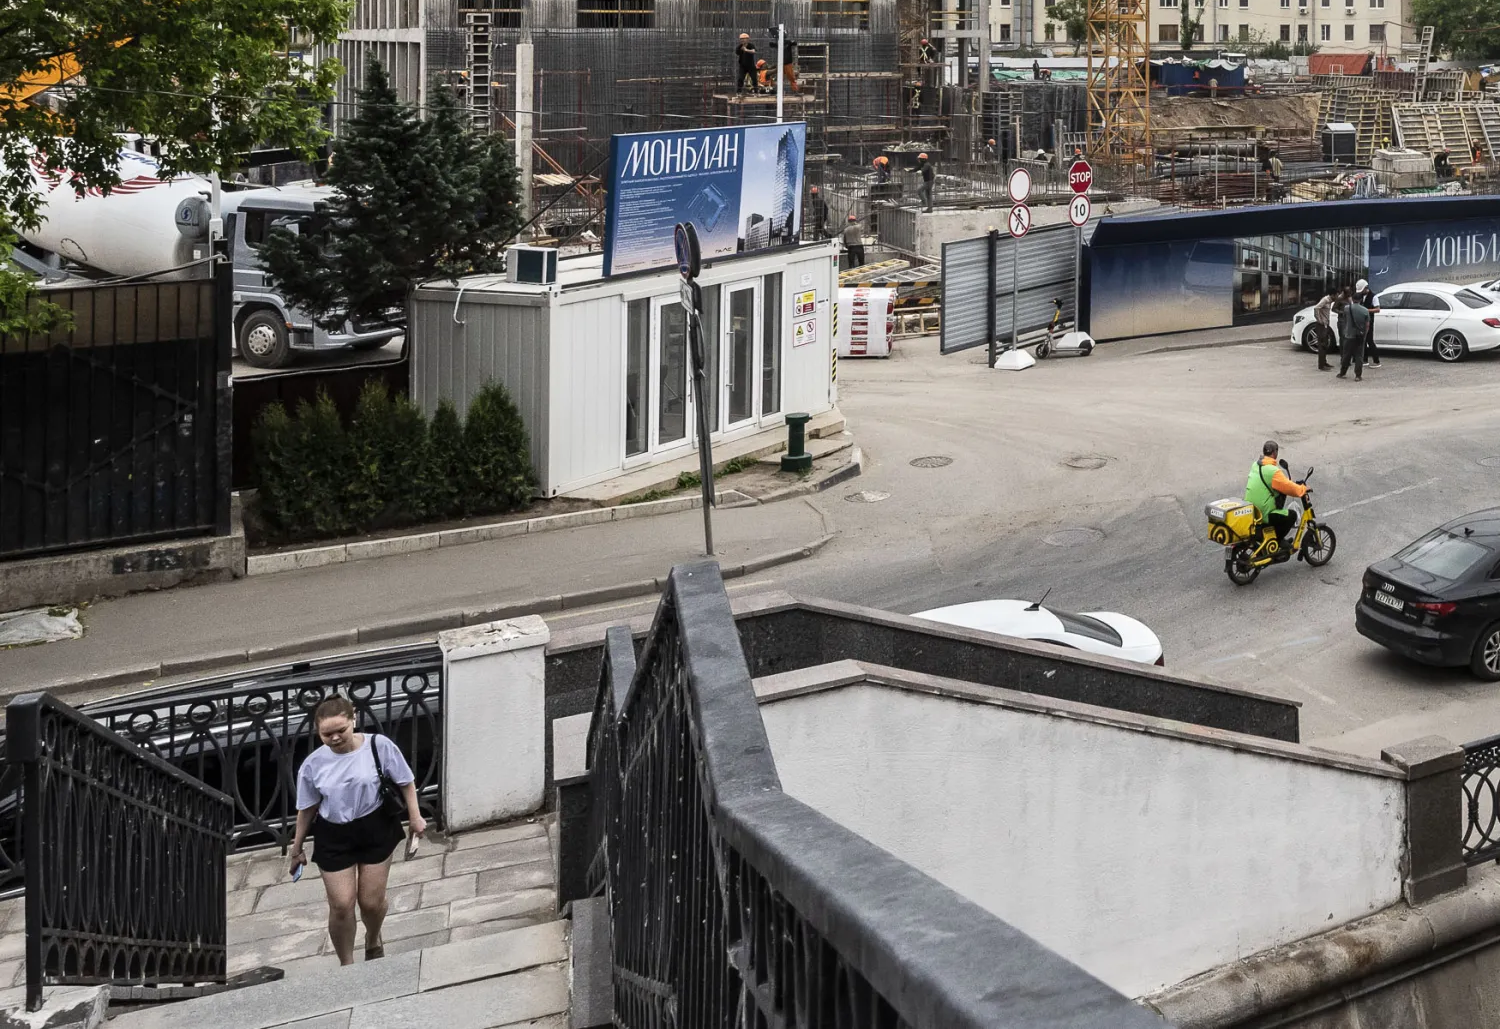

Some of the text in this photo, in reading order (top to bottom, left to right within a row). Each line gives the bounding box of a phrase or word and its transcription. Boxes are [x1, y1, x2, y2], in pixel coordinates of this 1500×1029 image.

[620, 132, 739, 178] МОНБЛАН
[1070, 171, 1091, 184] STOP
[1074, 203, 1086, 218] 10
